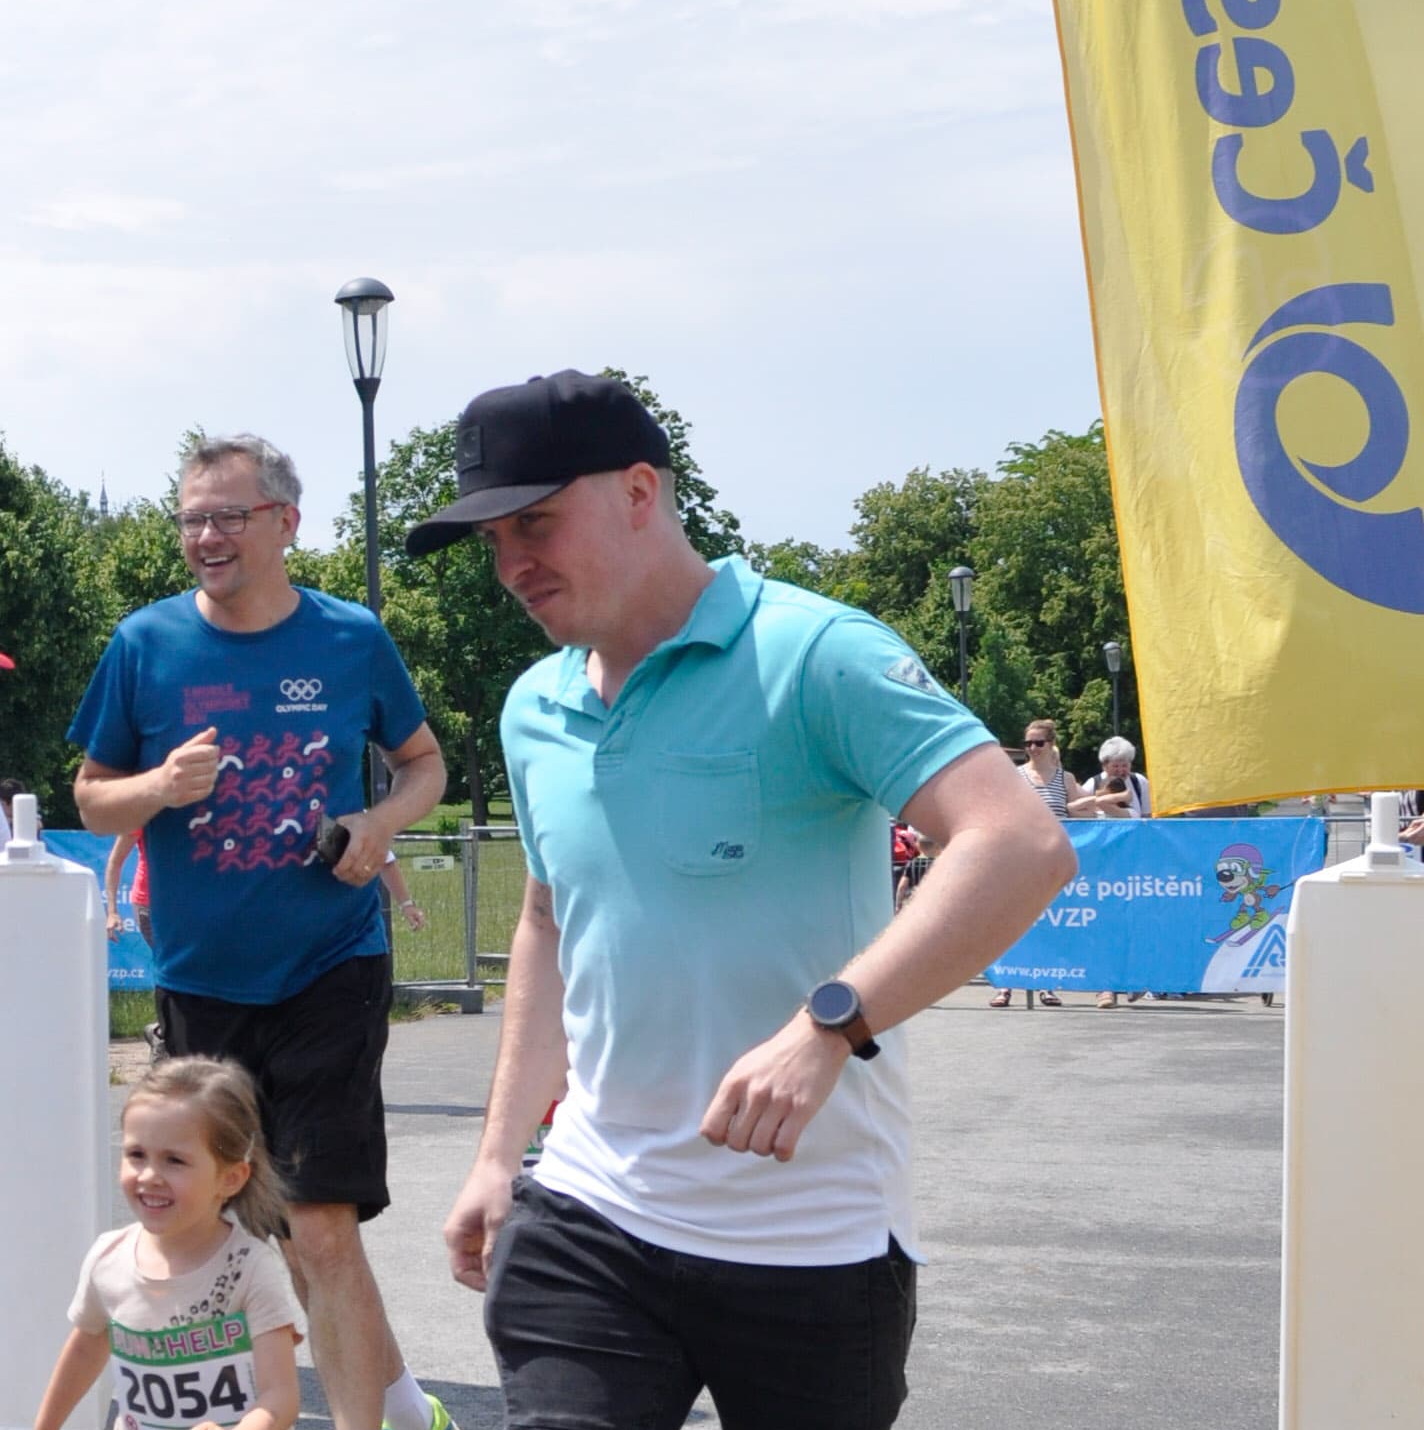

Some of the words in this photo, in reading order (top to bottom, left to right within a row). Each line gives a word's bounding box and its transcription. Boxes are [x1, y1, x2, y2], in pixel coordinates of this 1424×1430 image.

[1062, 875, 1090, 897] vé
[1097, 875, 1203, 901] pojištění
[993, 964, 1086, 980] www.pvzp.cz
[164, 1319, 244, 1358] HELP
[120, 1364, 248, 1419] 2054
